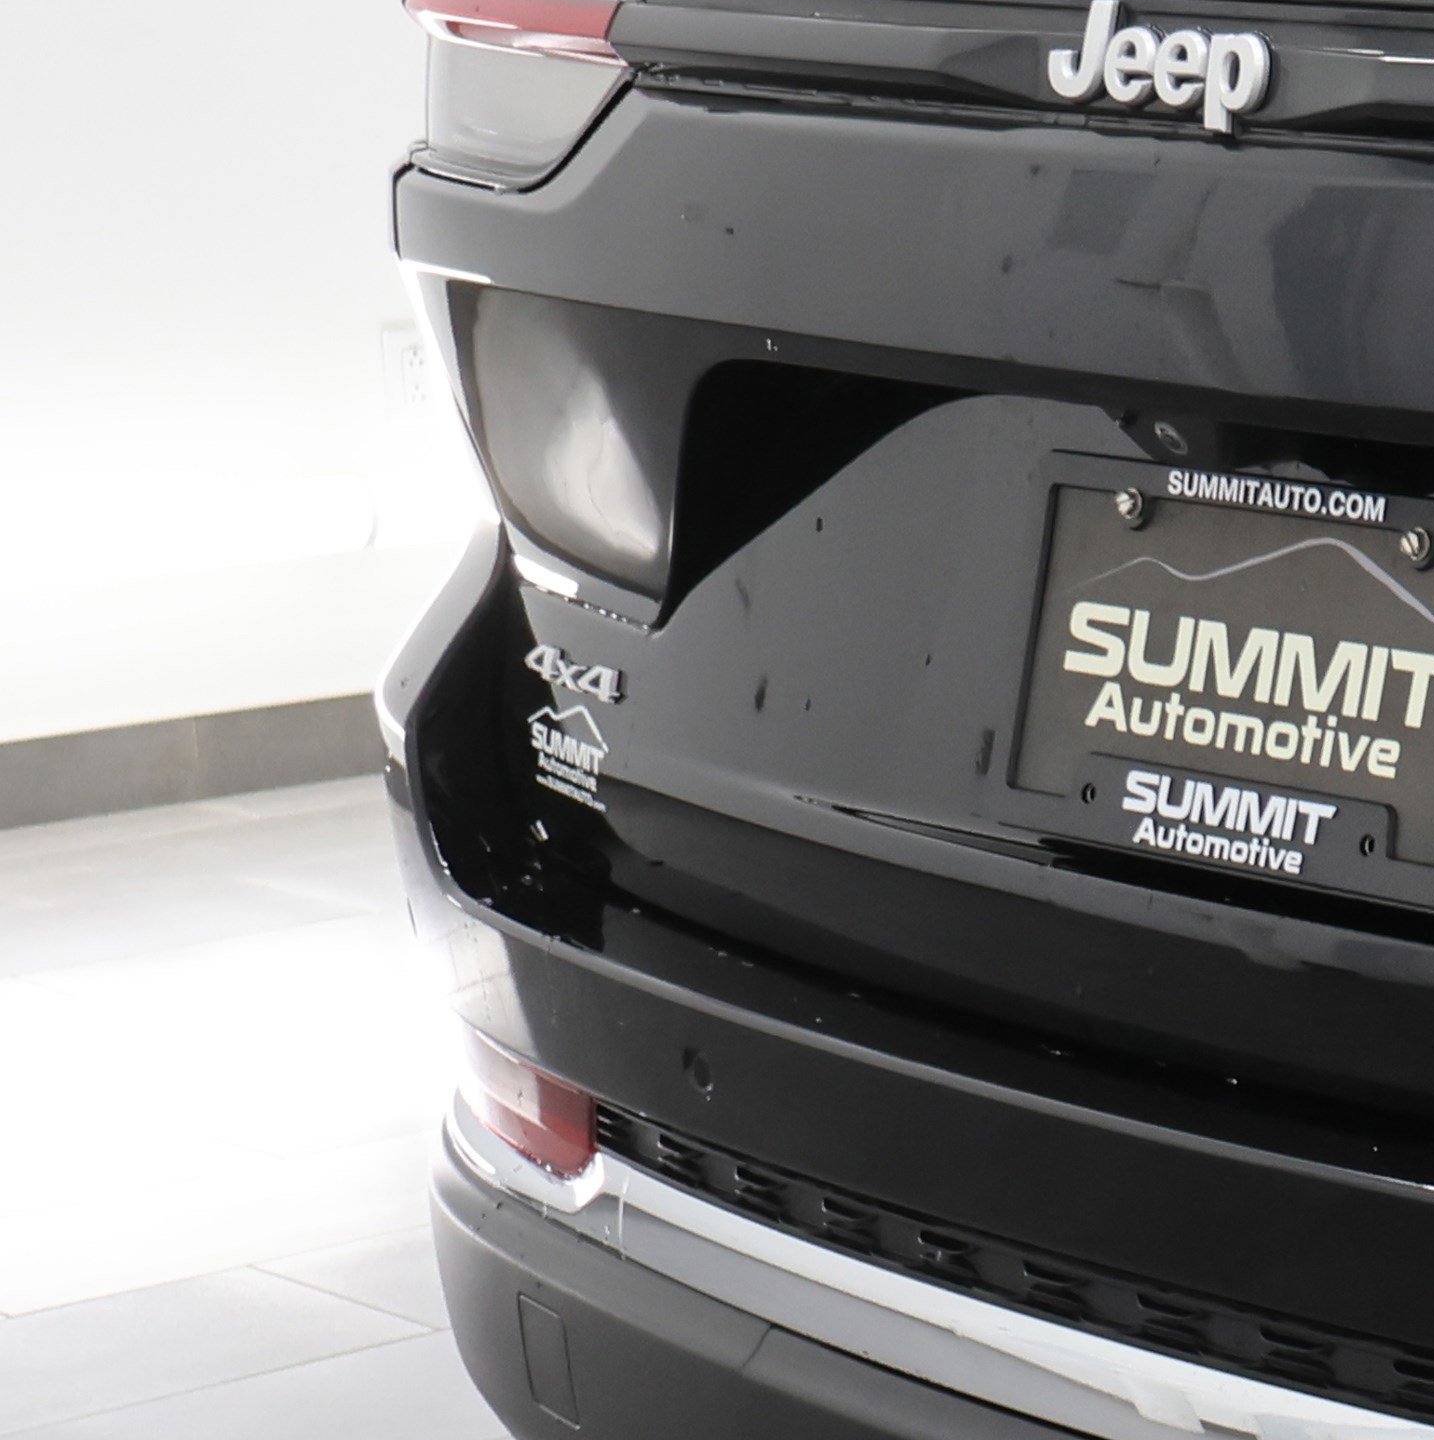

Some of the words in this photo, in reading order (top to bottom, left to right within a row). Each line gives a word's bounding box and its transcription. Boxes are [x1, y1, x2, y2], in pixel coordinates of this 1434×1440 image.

[1167, 470, 1386, 522] SUMMITAUTO.COM
[524, 644, 622, 704] 4x4
[531, 721, 605, 776] SUMMIT
[1084, 681, 1401, 779] Automotive
[1121, 769, 1338, 845] SUMMIT
[1133, 817, 1303, 876] Automotive
